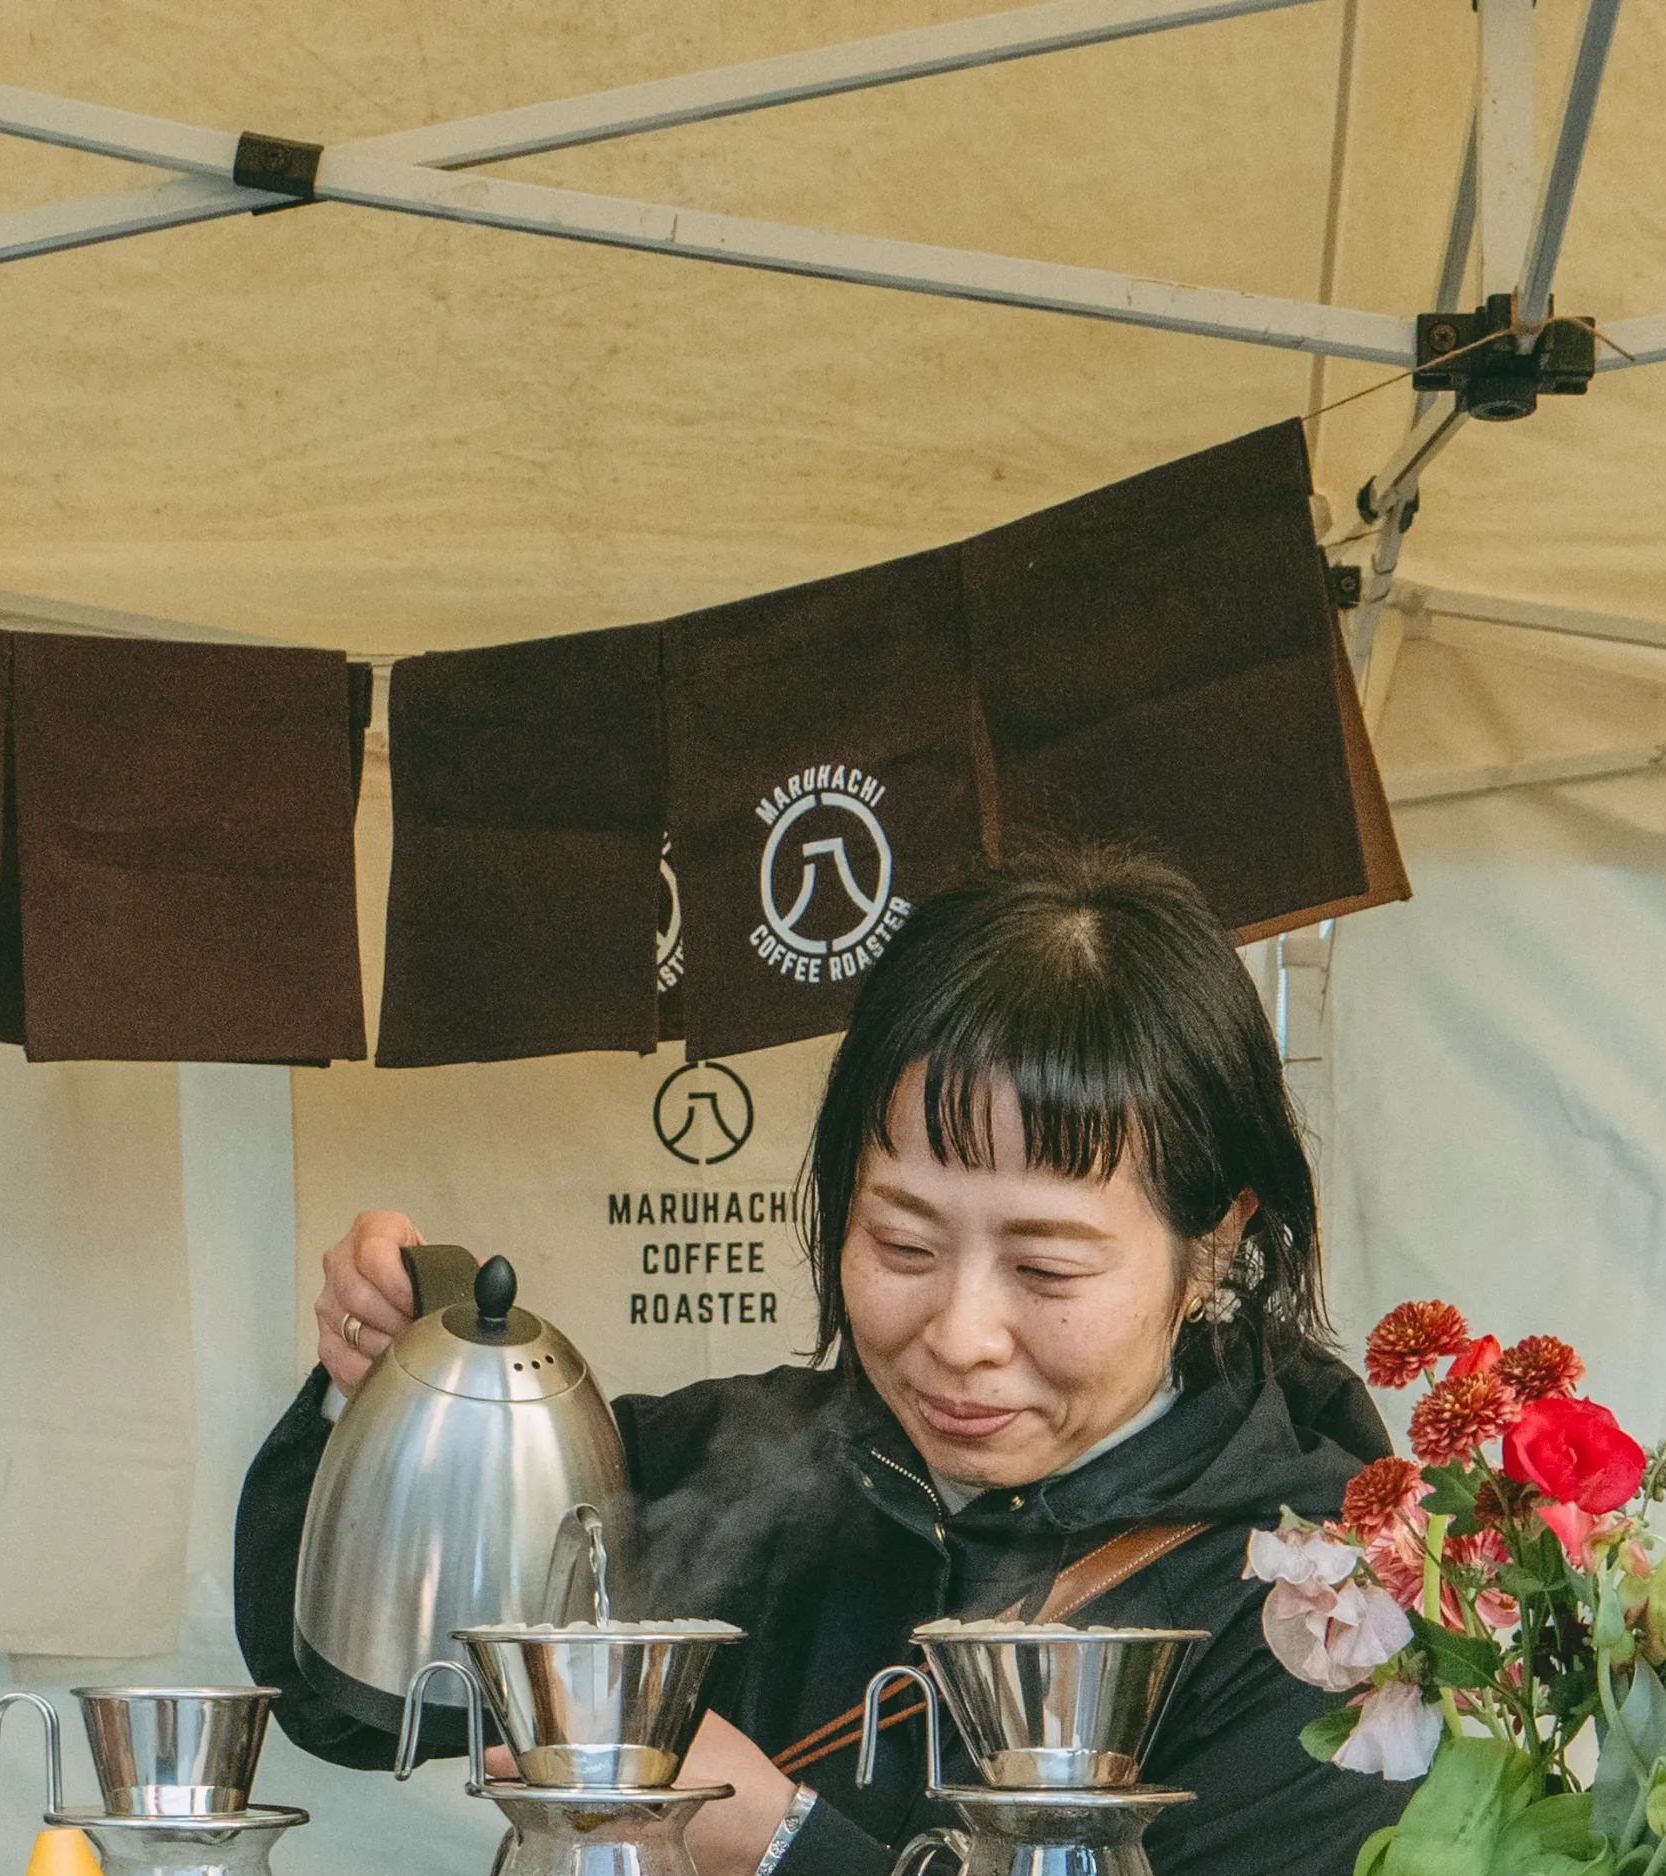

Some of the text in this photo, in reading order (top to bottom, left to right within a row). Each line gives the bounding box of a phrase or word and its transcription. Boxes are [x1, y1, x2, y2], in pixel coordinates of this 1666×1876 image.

[755, 764, 885, 826] MARUHACHI
[749, 923, 821, 984] COFFEE
[829, 895, 914, 983] ROASTER
[608, 1191, 799, 1226] MARUHACHI
[642, 1241, 765, 1275] COFFEE
[629, 1290, 779, 1325] ROASTER
